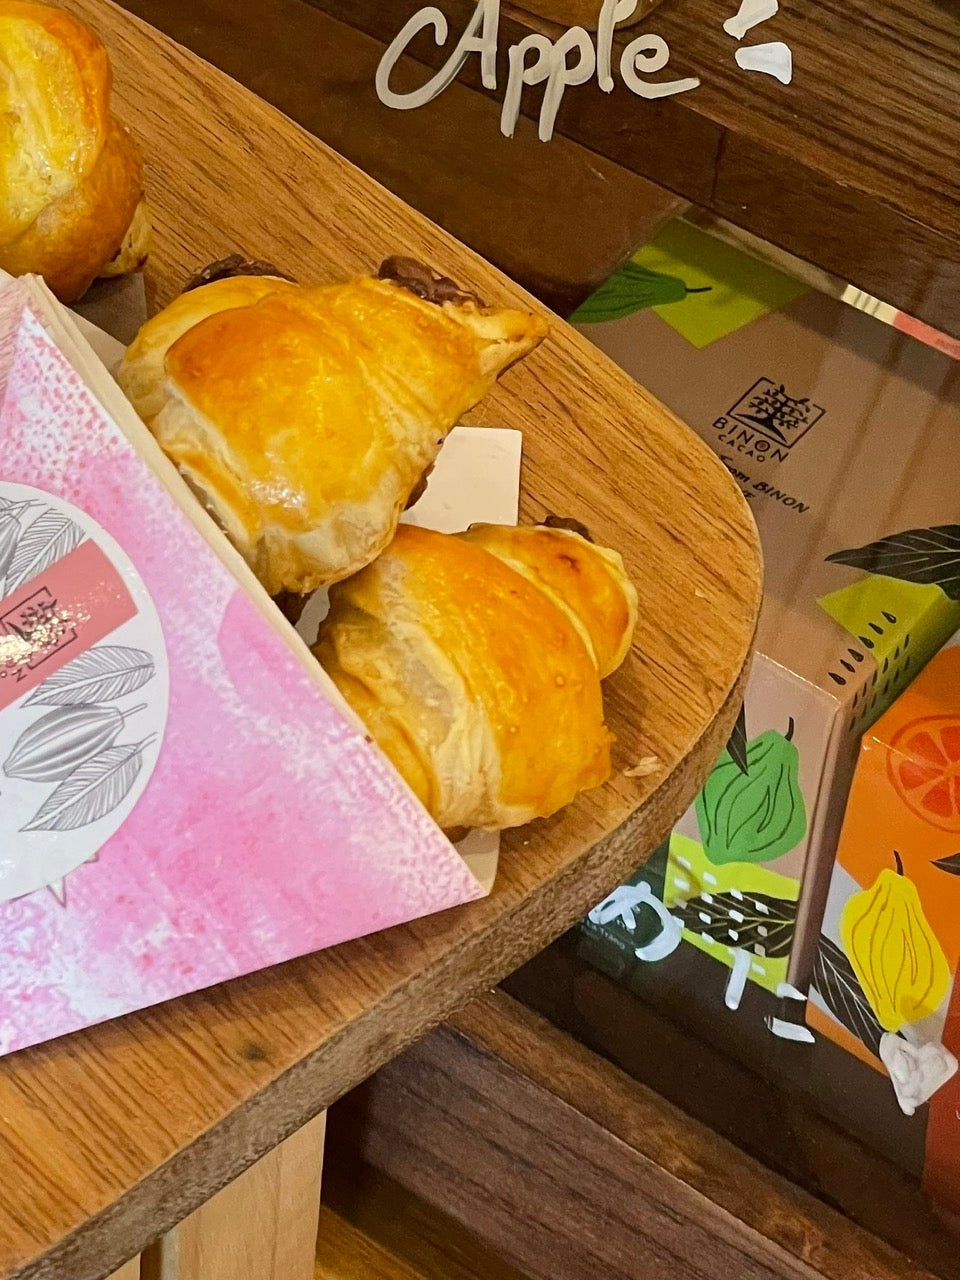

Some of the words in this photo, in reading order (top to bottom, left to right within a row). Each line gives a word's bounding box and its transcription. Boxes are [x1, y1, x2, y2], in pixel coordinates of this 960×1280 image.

[711, 416, 790, 464] BINON
[717, 433, 766, 464] CACAO
[752, 481, 810, 514] BINON
